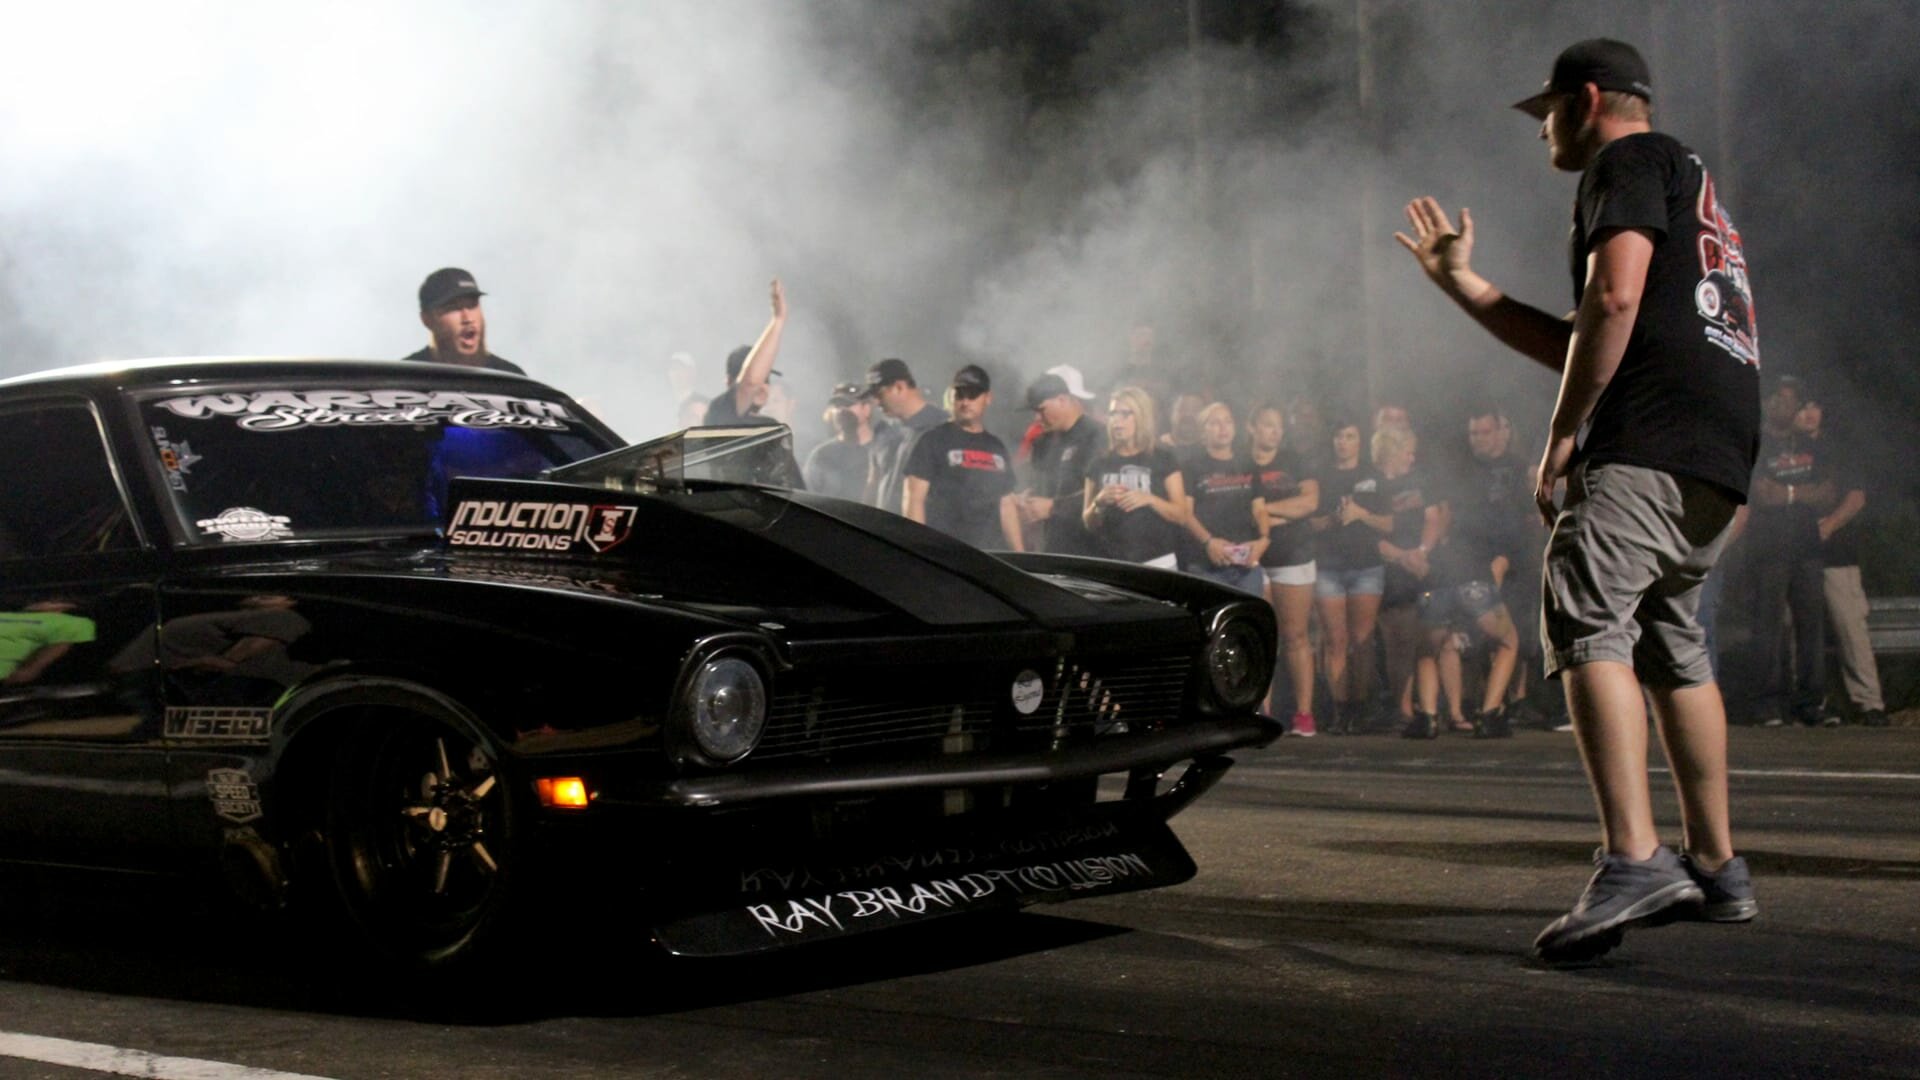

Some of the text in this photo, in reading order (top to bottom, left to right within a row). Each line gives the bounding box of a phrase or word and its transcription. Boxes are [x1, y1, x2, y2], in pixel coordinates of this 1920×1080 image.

[154, 389, 571, 420] WARPATH
[237, 407, 570, 432] Street Cars
[448, 501, 588, 543] INDUCTION
[451, 530, 572, 551] SOLUTIONS
[746, 895, 845, 936] RAY
[1014, 852, 1154, 892] COLLISION
